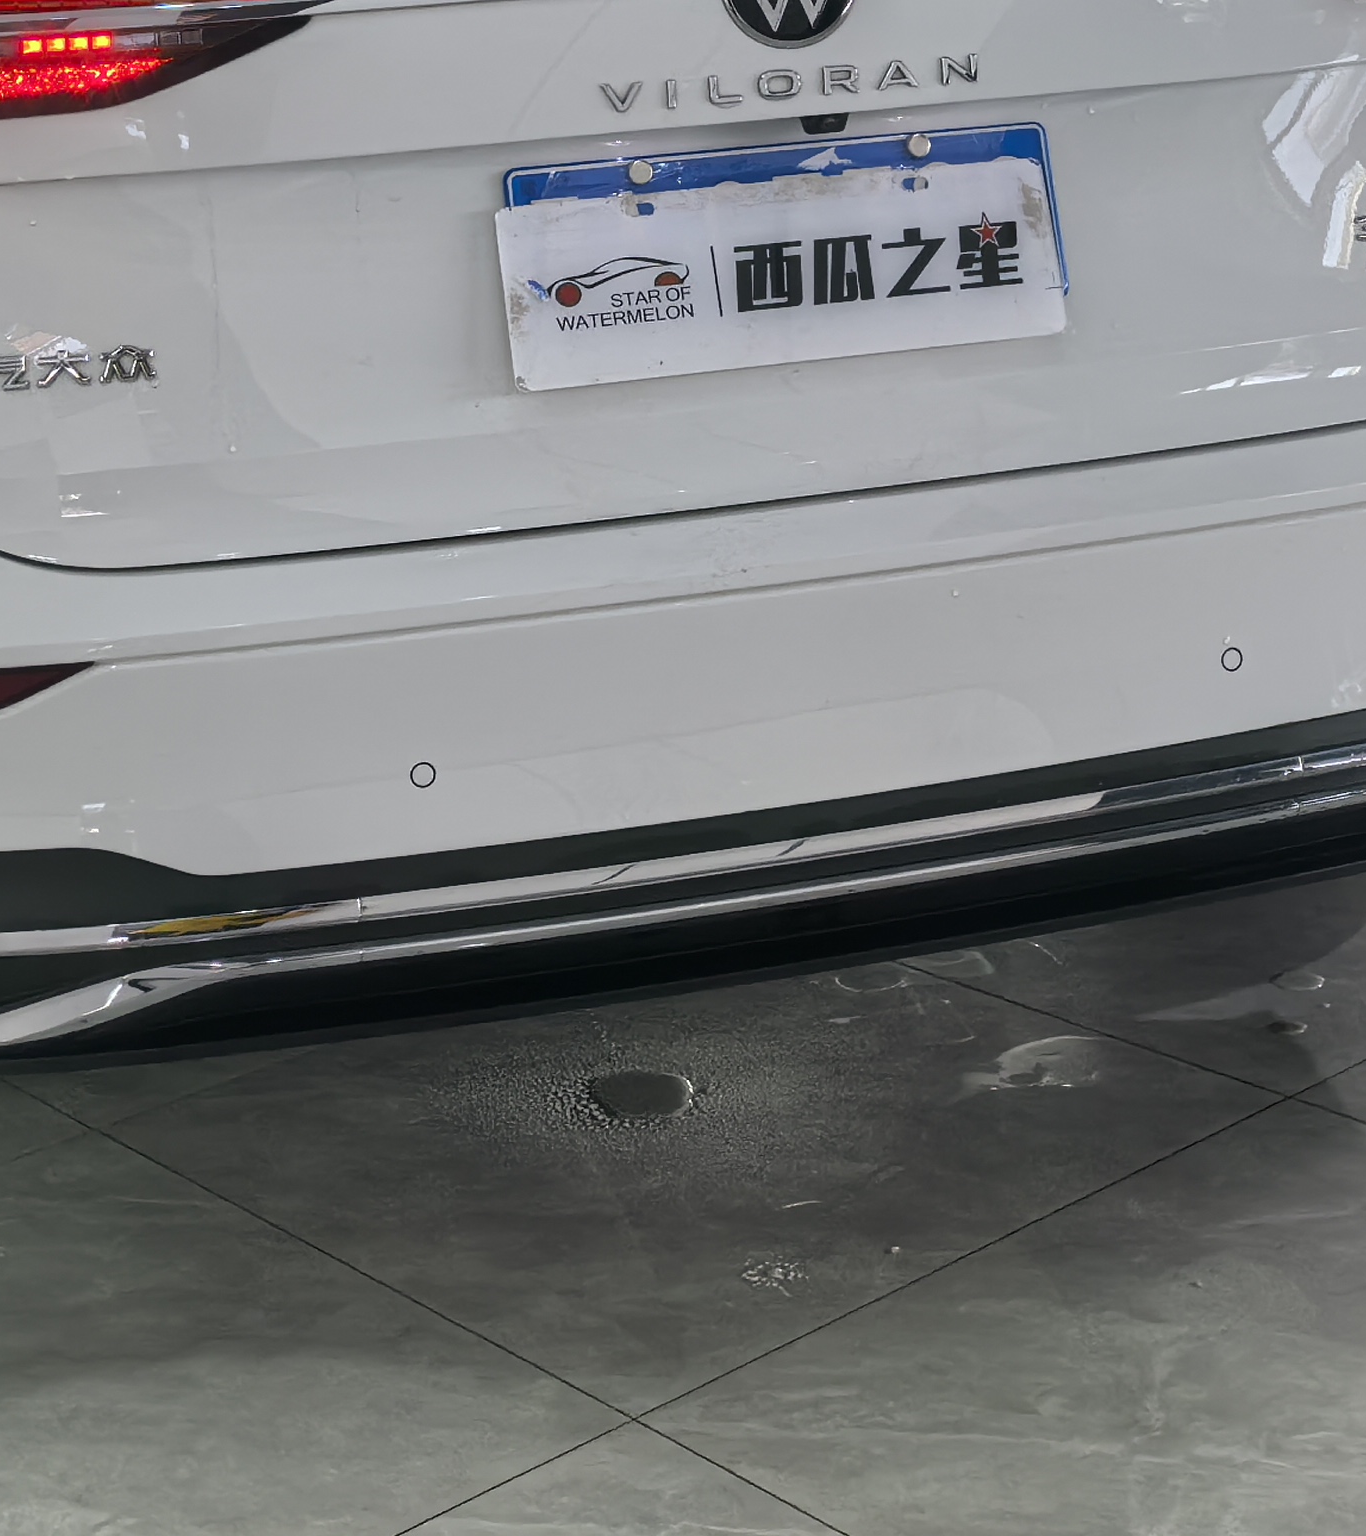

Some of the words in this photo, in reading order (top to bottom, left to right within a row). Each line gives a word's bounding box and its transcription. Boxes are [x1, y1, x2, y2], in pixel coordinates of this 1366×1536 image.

[598, 52, 981, 114] VILORAN
[733, 214, 1024, 313] 西瓜之星
[555, 303, 696, 332] WATERMELON
[609, 290, 661, 307] STAR
[664, 285, 692, 302] OF
